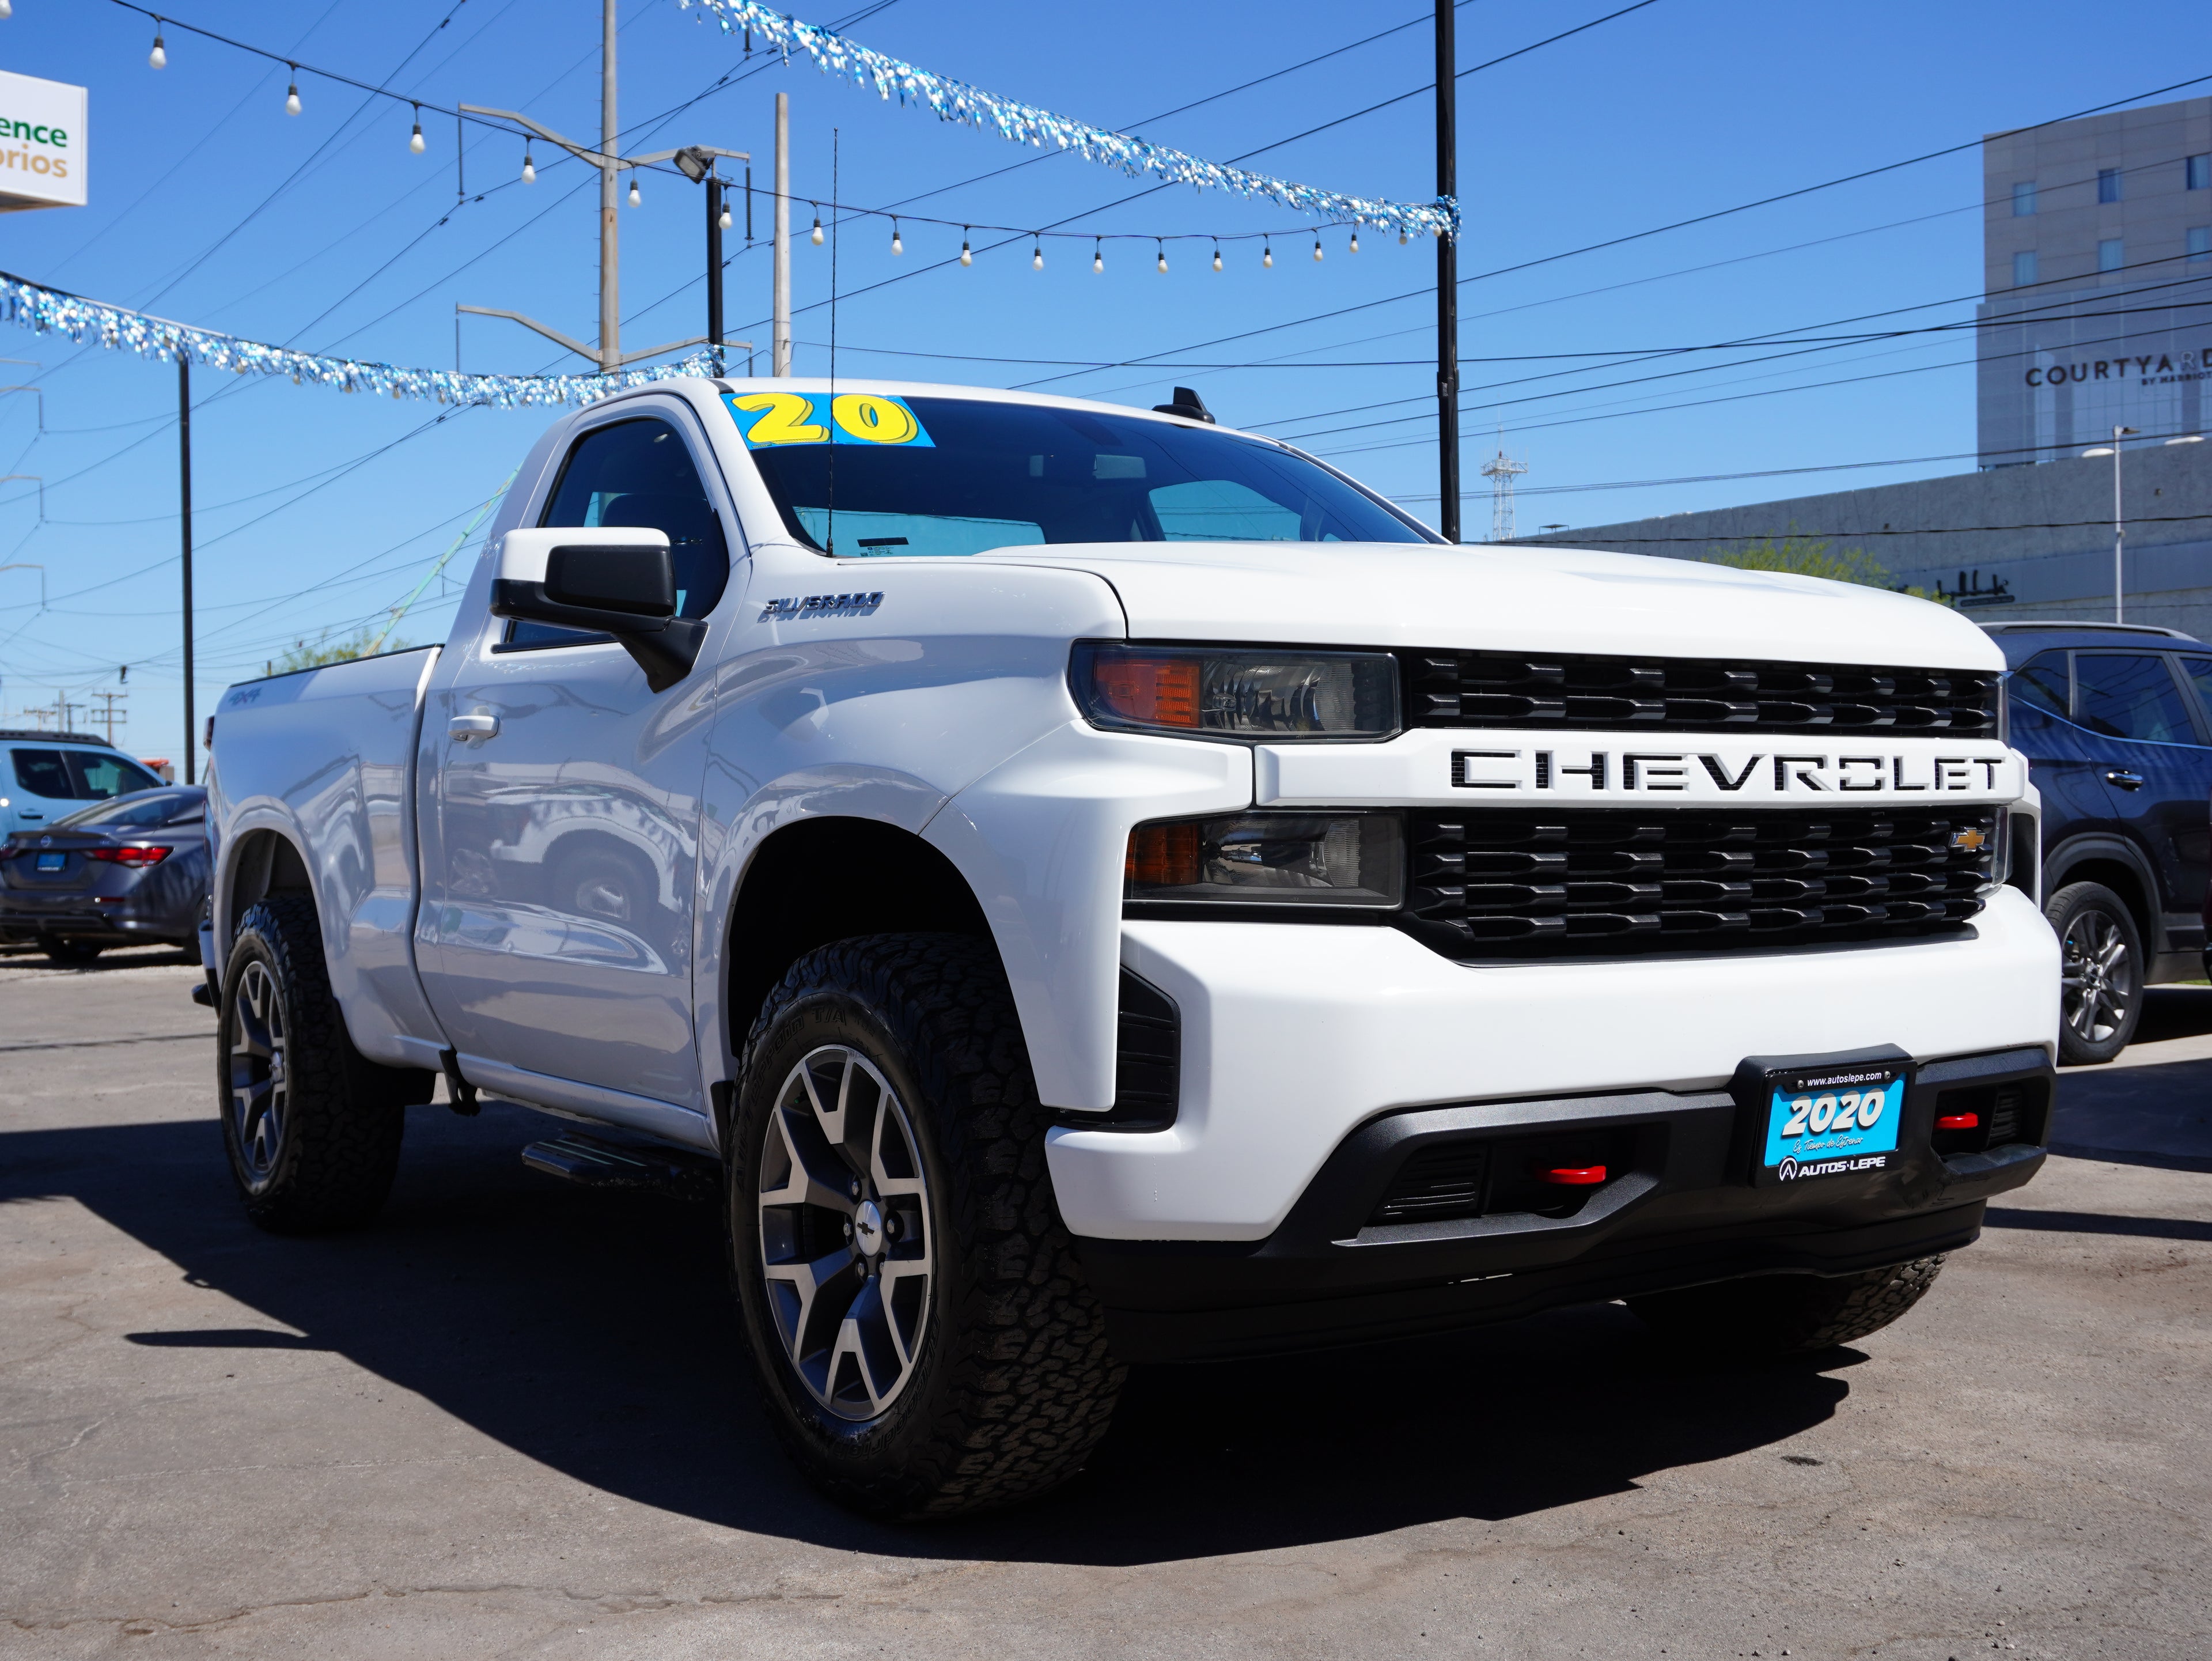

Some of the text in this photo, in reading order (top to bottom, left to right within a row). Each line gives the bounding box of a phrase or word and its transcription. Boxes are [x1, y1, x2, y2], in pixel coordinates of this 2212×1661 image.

[732, 392, 919, 444] 20
[763, 591, 886, 614] SILVERADO
[1451, 748, 2006, 792] CHEVROLET
[1807, 1071, 1882, 1087] www.autoslepe.com
[1782, 1088, 1885, 1136] 2020
